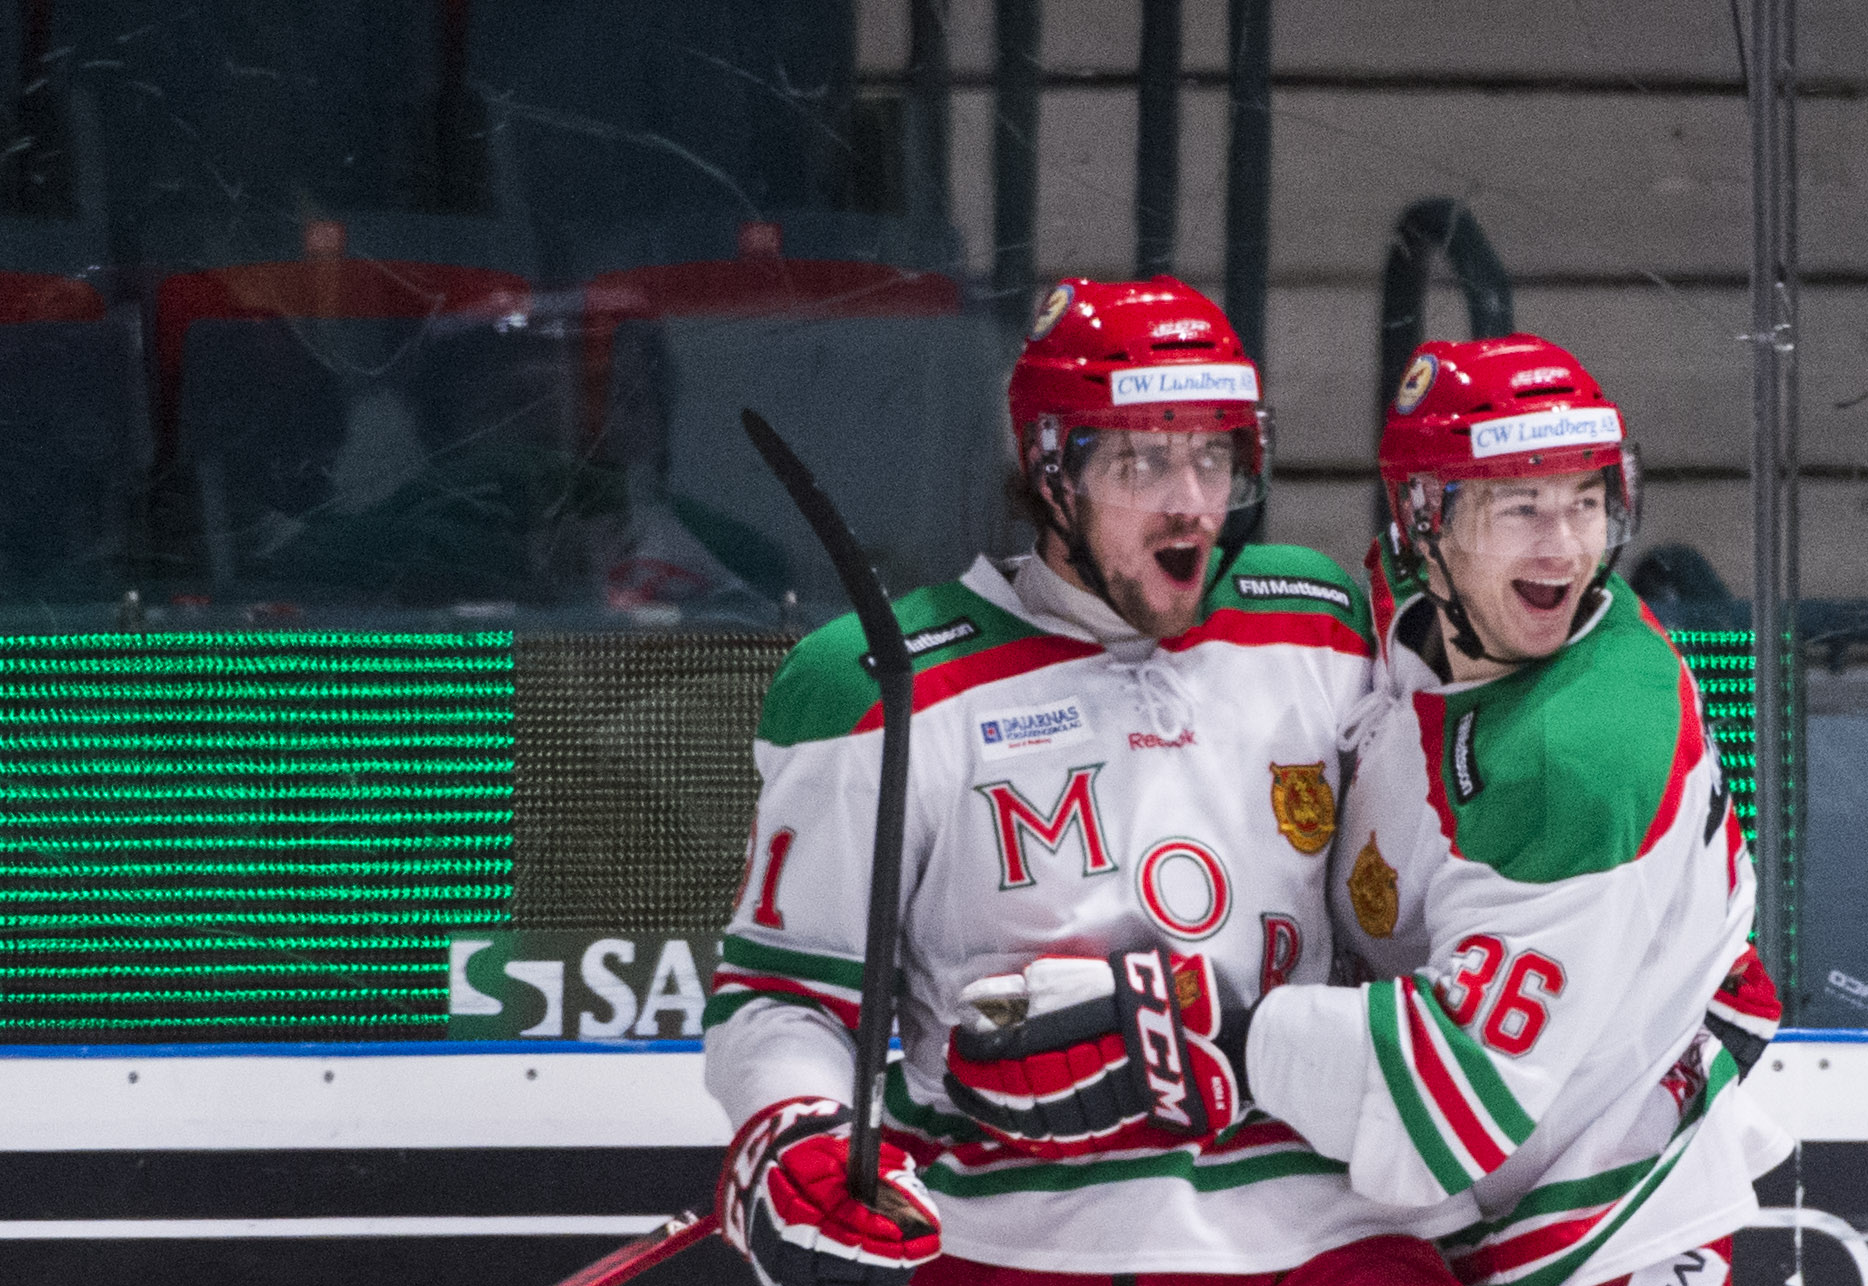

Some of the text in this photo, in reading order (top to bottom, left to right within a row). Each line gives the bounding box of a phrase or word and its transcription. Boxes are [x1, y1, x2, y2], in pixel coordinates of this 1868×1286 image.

[1518, 416, 1598, 442] Lundberg
[578, 938, 726, 1038] SA
[1124, 949, 1192, 1127] CCM
[1440, 934, 1567, 1058] 36
